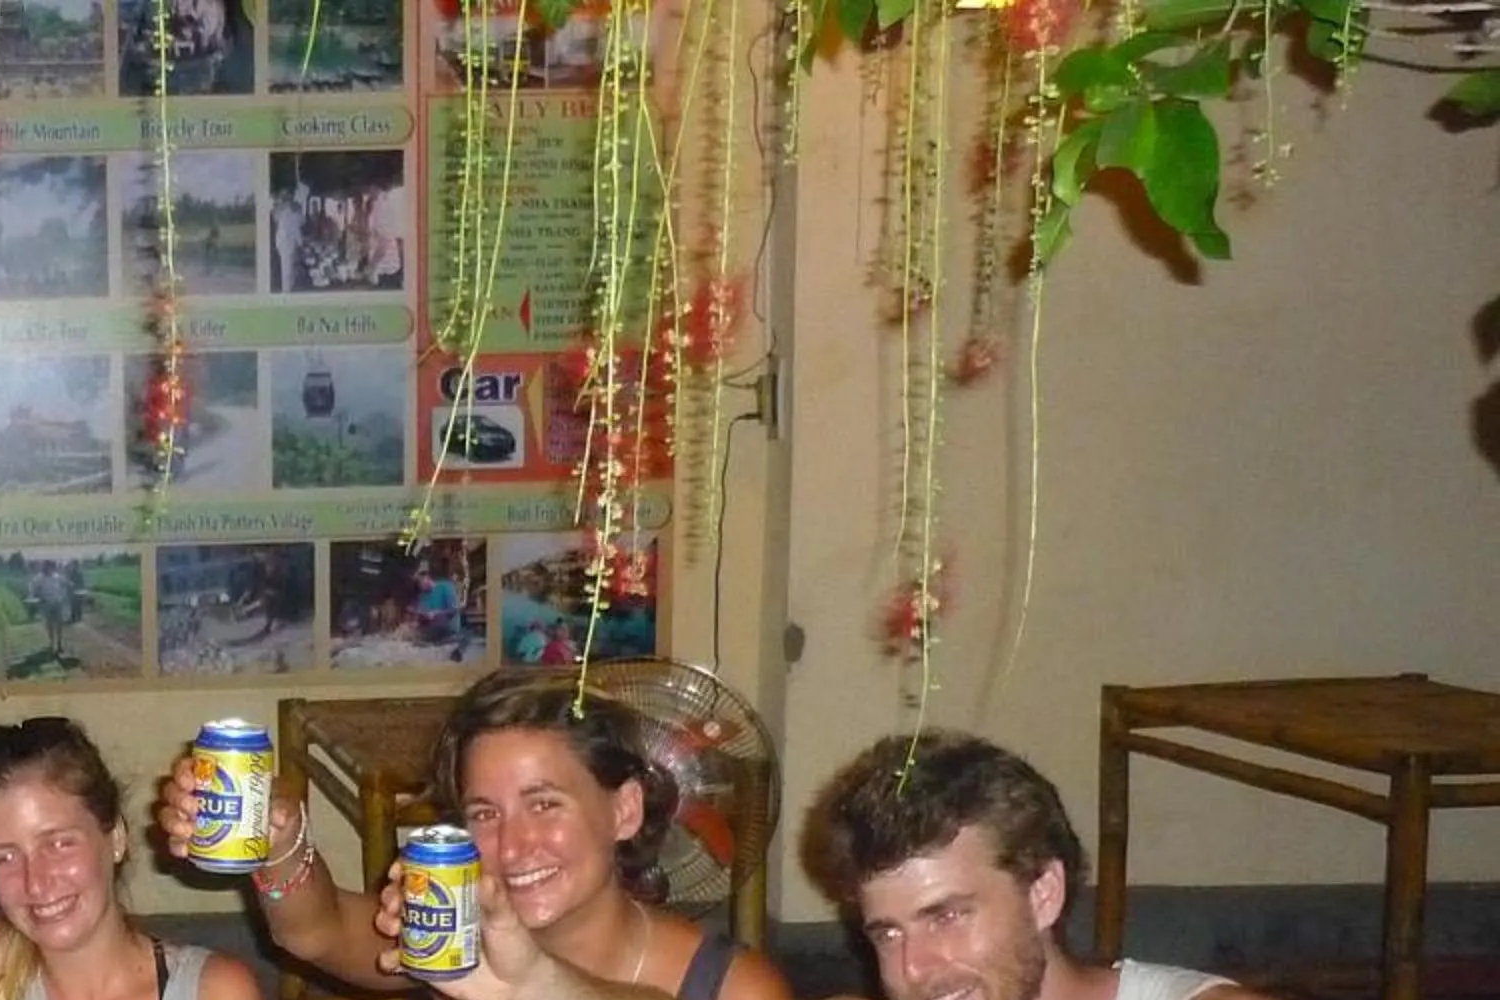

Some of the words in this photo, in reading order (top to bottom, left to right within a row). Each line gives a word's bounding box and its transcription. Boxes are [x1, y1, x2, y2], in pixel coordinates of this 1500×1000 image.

[33, 121, 100, 142] Mountain
[141, 118, 196, 141] Bicycle
[202, 119, 232, 137] Tour
[281, 116, 345, 139] Cooking
[351, 114, 391, 134] Class
[297, 315, 315, 333] Ba
[319, 316, 340, 333] Na
[344, 315, 377, 332] Hills
[440, 366, 521, 402] Car
[197, 796, 239, 815] RUE
[403, 909, 453, 928] RUE
